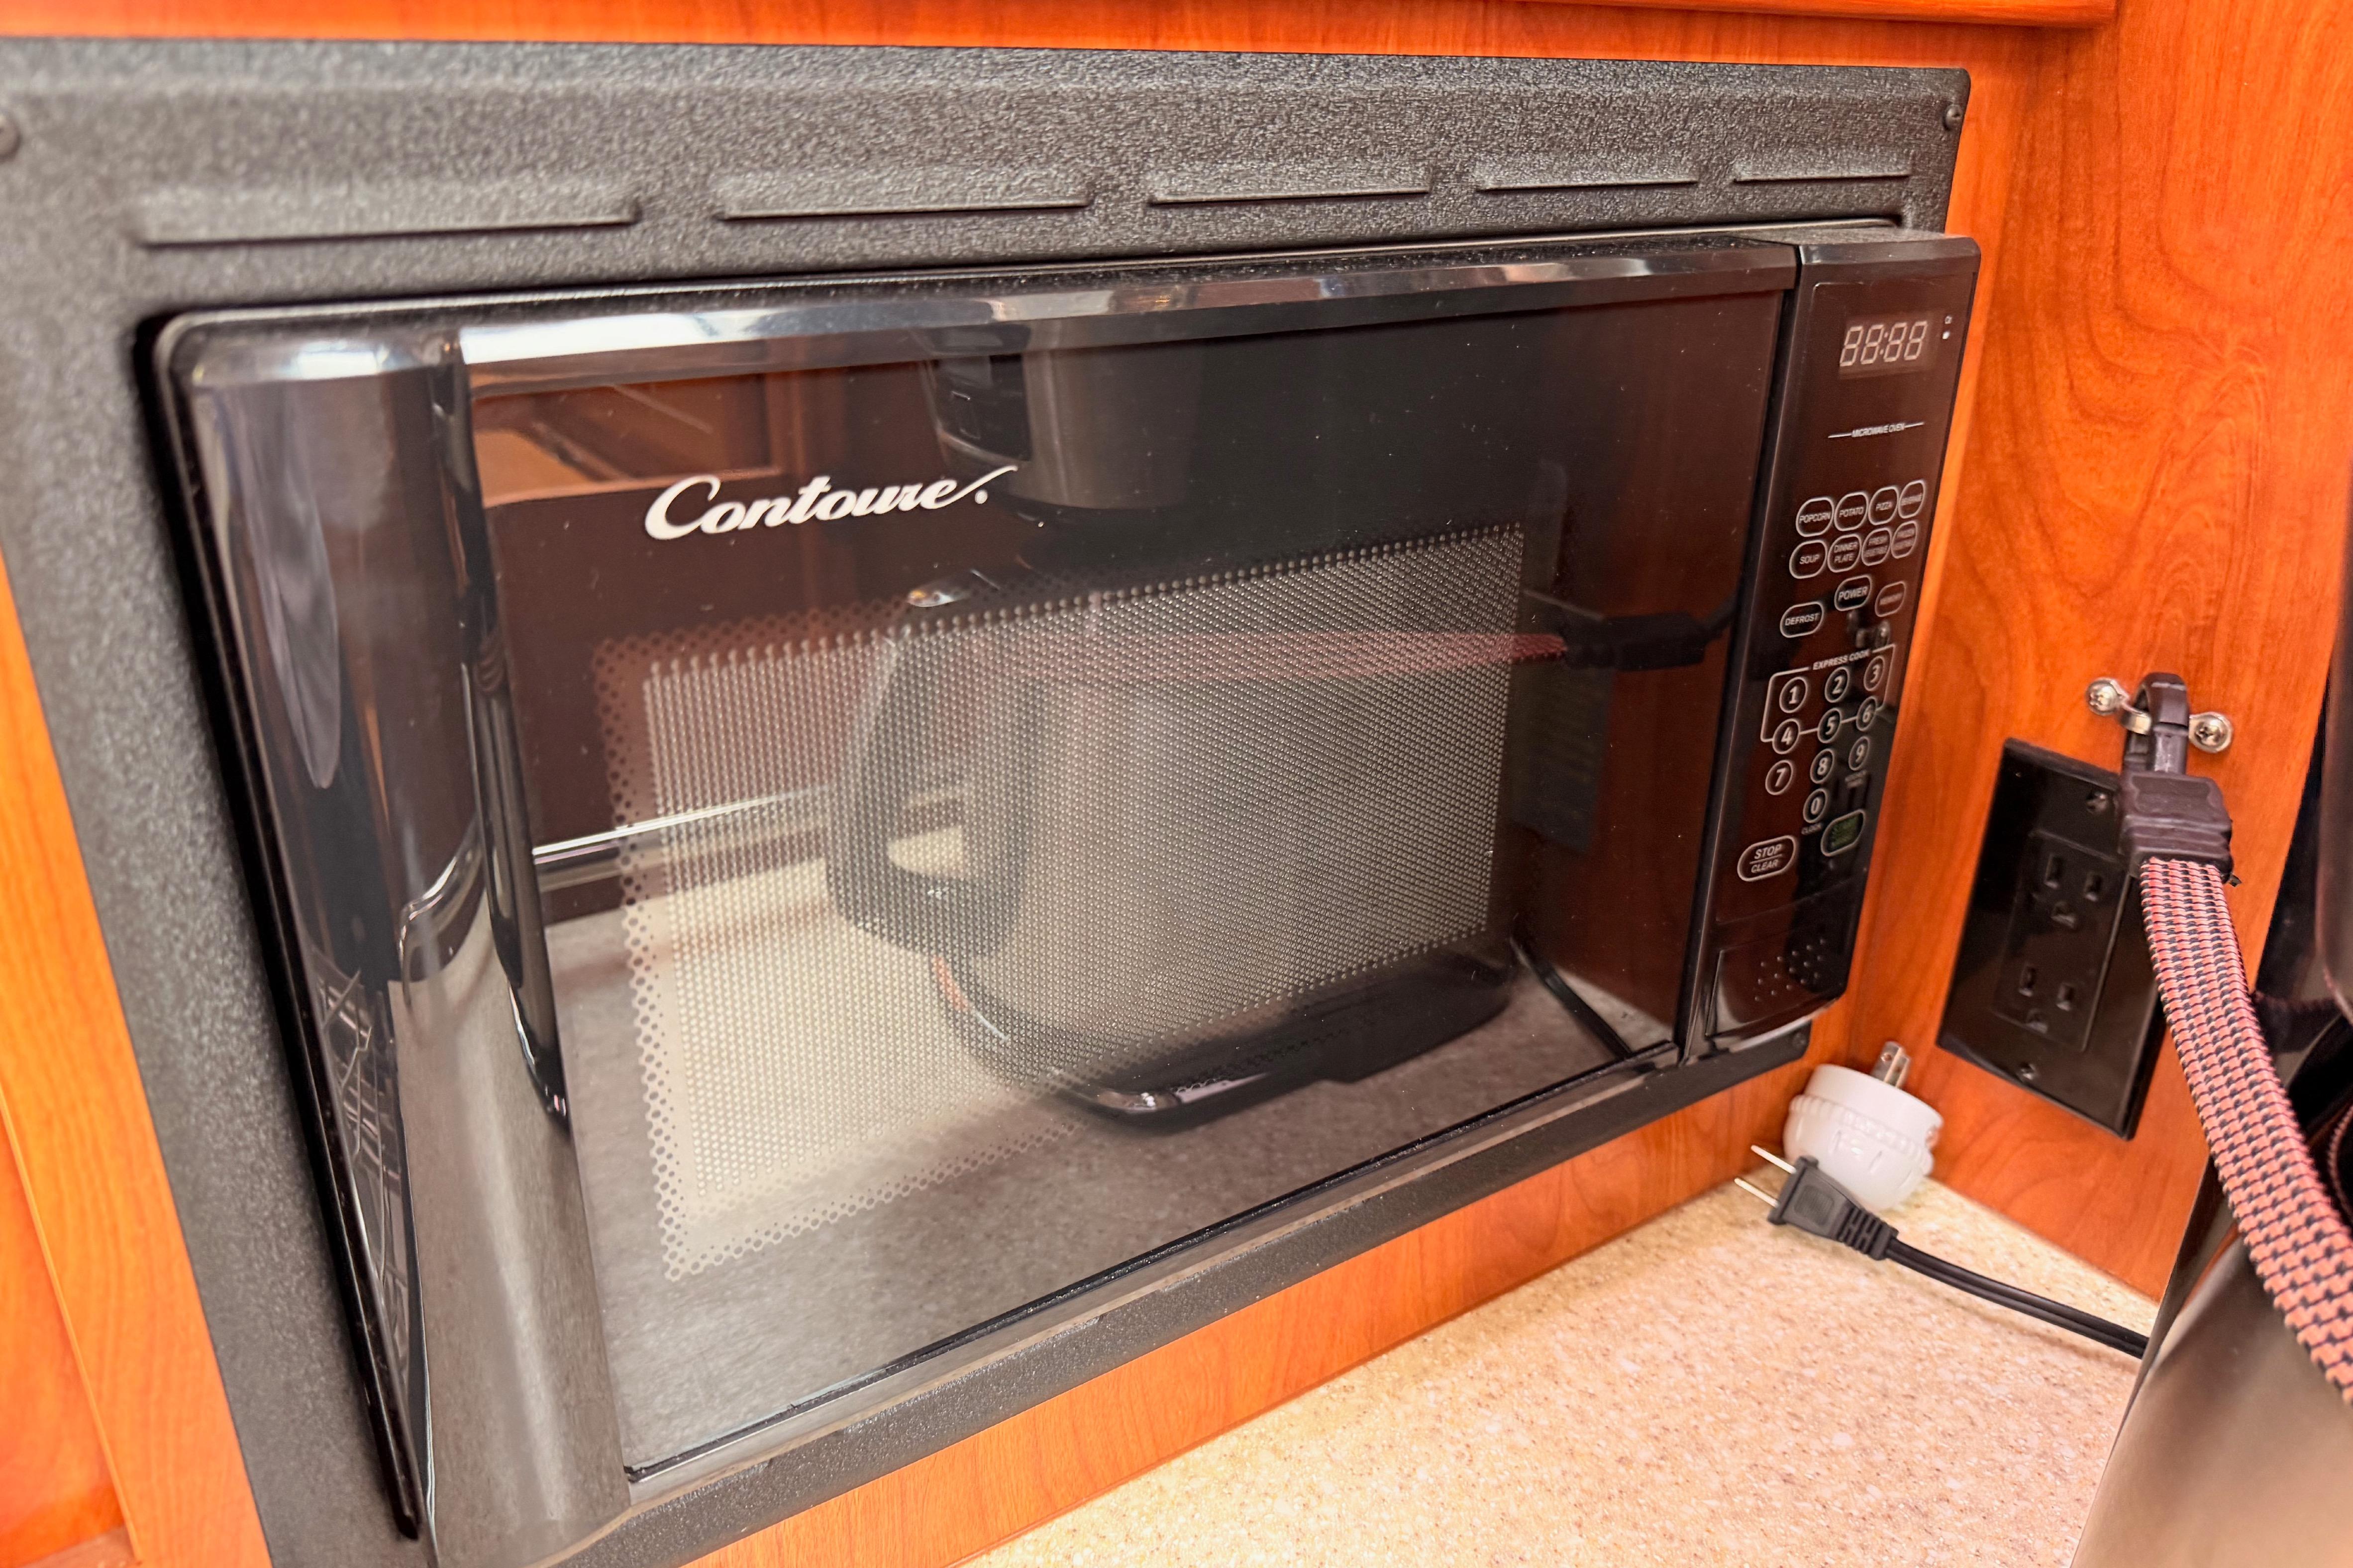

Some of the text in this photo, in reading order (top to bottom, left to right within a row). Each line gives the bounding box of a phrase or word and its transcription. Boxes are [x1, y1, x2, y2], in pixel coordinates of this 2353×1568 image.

[644, 465, 1019, 540] Contoure
[1875, 501, 1893, 511] PIZZA
[1799, 512, 1831, 524] POPCORN
[1839, 506, 1864, 518] POTATO
[1834, 542, 1858, 553] DINNER
[1799, 554, 1820, 565] SOUP
[1834, 553, 1855, 563] PLATE
[1839, 587, 1868, 601] POWER
[1784, 613, 1820, 626] DEFROST
[1813, 649, 1870, 670] EXPRESS COOK
[1870, 665, 1880, 684] 3
[1832, 678, 1842, 694] 2
[1788, 686, 1798, 704] 1
[1863, 704, 1873, 721] 6
[1825, 717, 1838, 735] 5
[1781, 726, 1792, 746] 4
[1856, 744, 1865, 762] 9
[1817, 757, 1828, 775] 8
[1775, 768, 1787, 787] 7
[1810, 796, 1821, 815] 0
[1754, 844, 1782, 860] STOP
[1751, 859, 1778, 874] CLEAR
